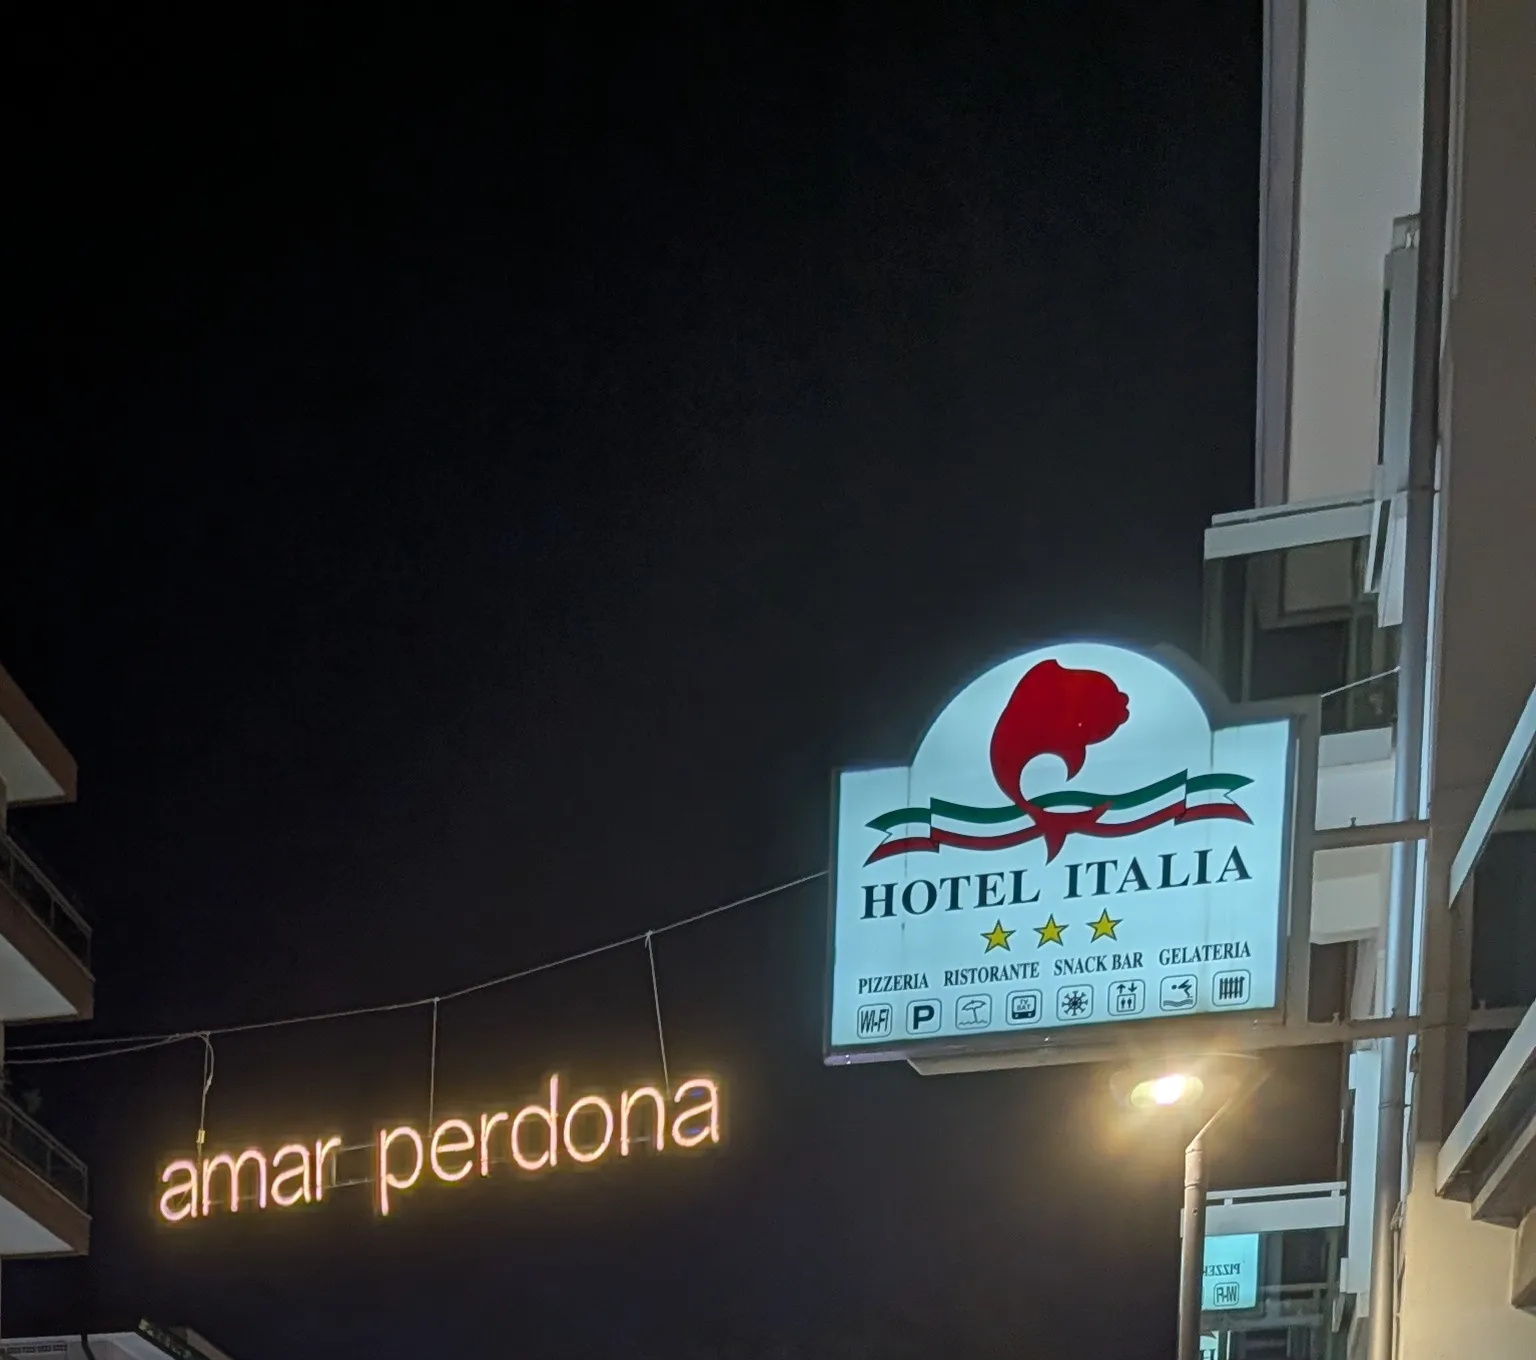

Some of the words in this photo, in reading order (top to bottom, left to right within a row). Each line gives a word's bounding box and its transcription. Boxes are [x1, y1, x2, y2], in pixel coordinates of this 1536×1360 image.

[860, 869, 1041, 920] HOTEL
[1063, 845, 1253, 900] ITALIA
[858, 972, 929, 995] PIZZERIA
[943, 961, 1040, 987] RISTORANTE
[1053, 954, 1109, 976] SNACK
[1111, 951, 1144, 971] BAR
[1158, 940, 1252, 966] GELATERIA
[860, 1008, 890, 1034] WI-FI
[912, 1004, 935, 1030] P
[159, 1134, 341, 1222] amar
[379, 1073, 720, 1216] perdona
